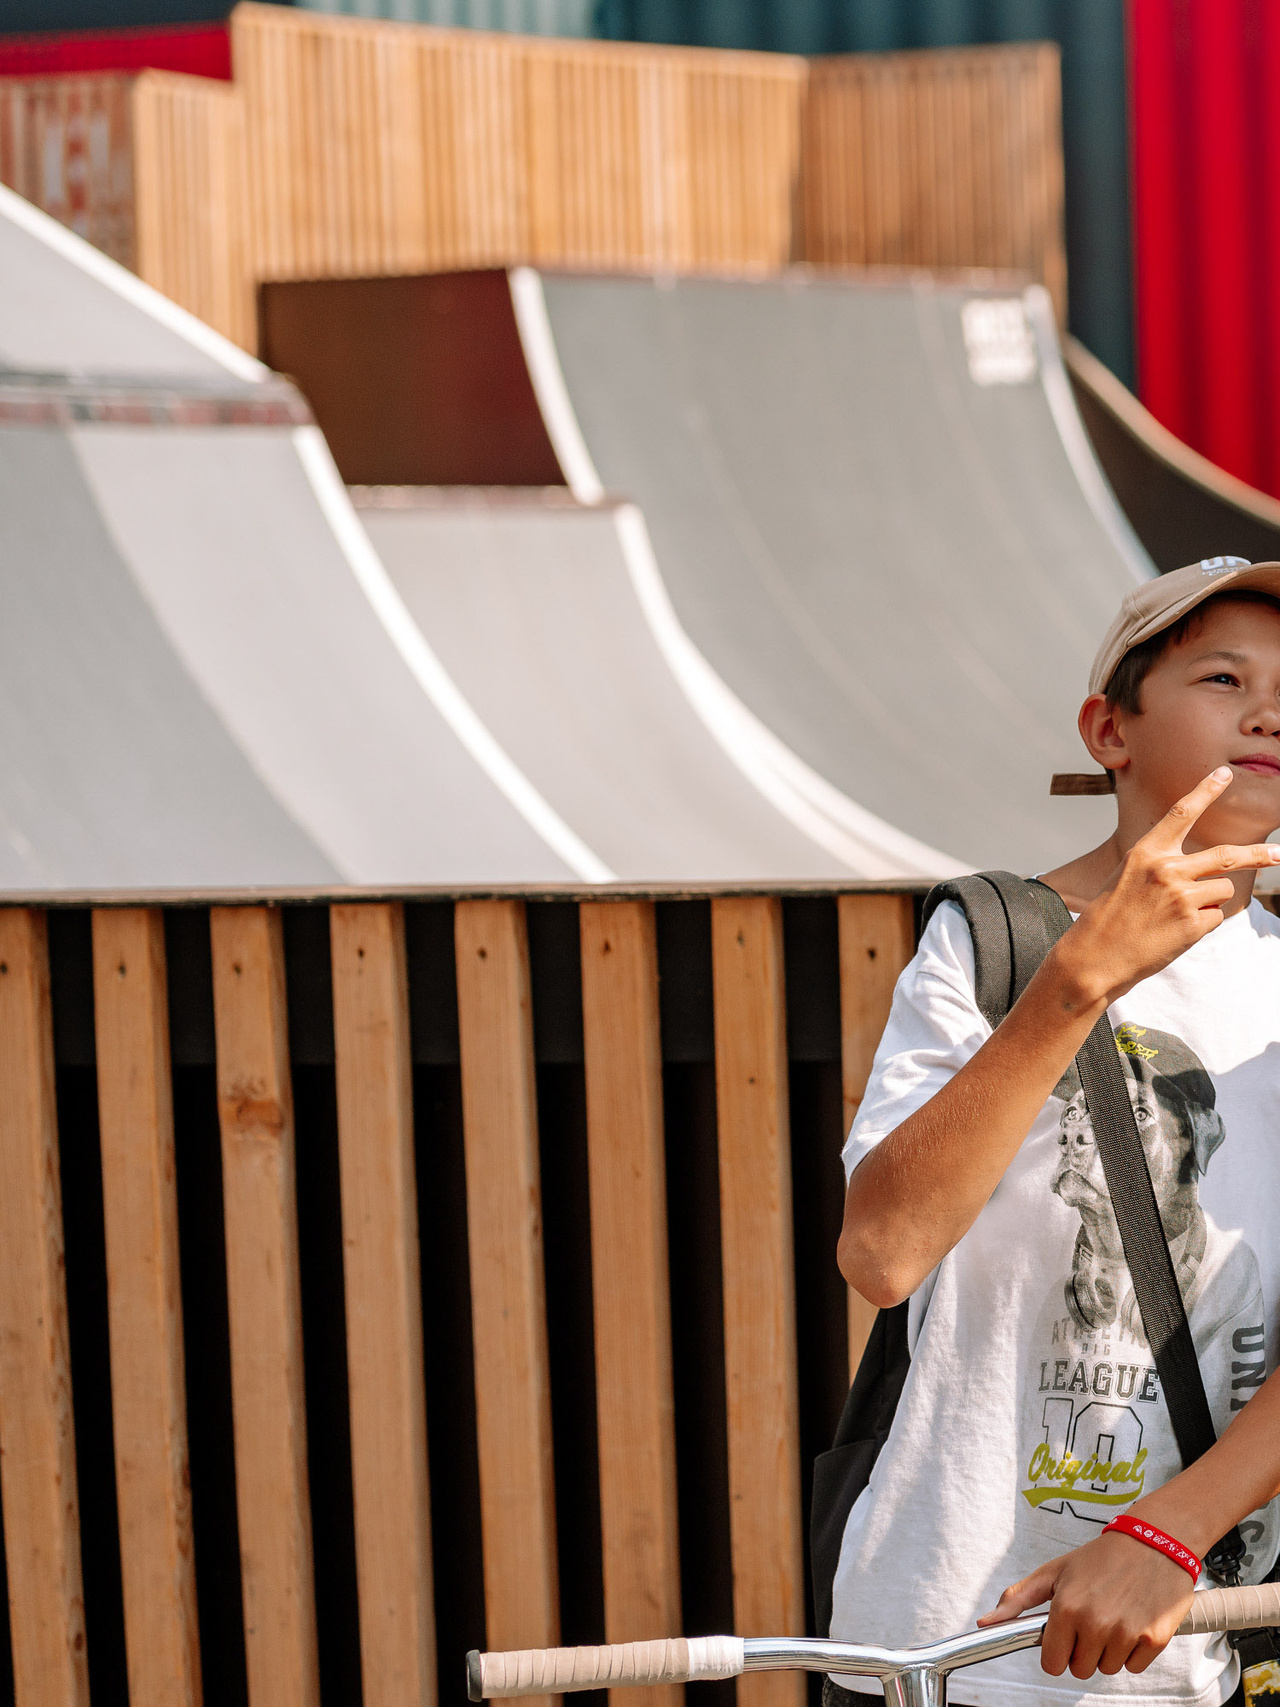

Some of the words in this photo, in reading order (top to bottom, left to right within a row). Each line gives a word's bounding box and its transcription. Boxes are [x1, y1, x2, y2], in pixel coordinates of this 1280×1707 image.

[1037, 1357, 1160, 1405] LEAGUE
[1027, 1442, 1149, 1492] Original
[1041, 1396, 1144, 1526] 10
